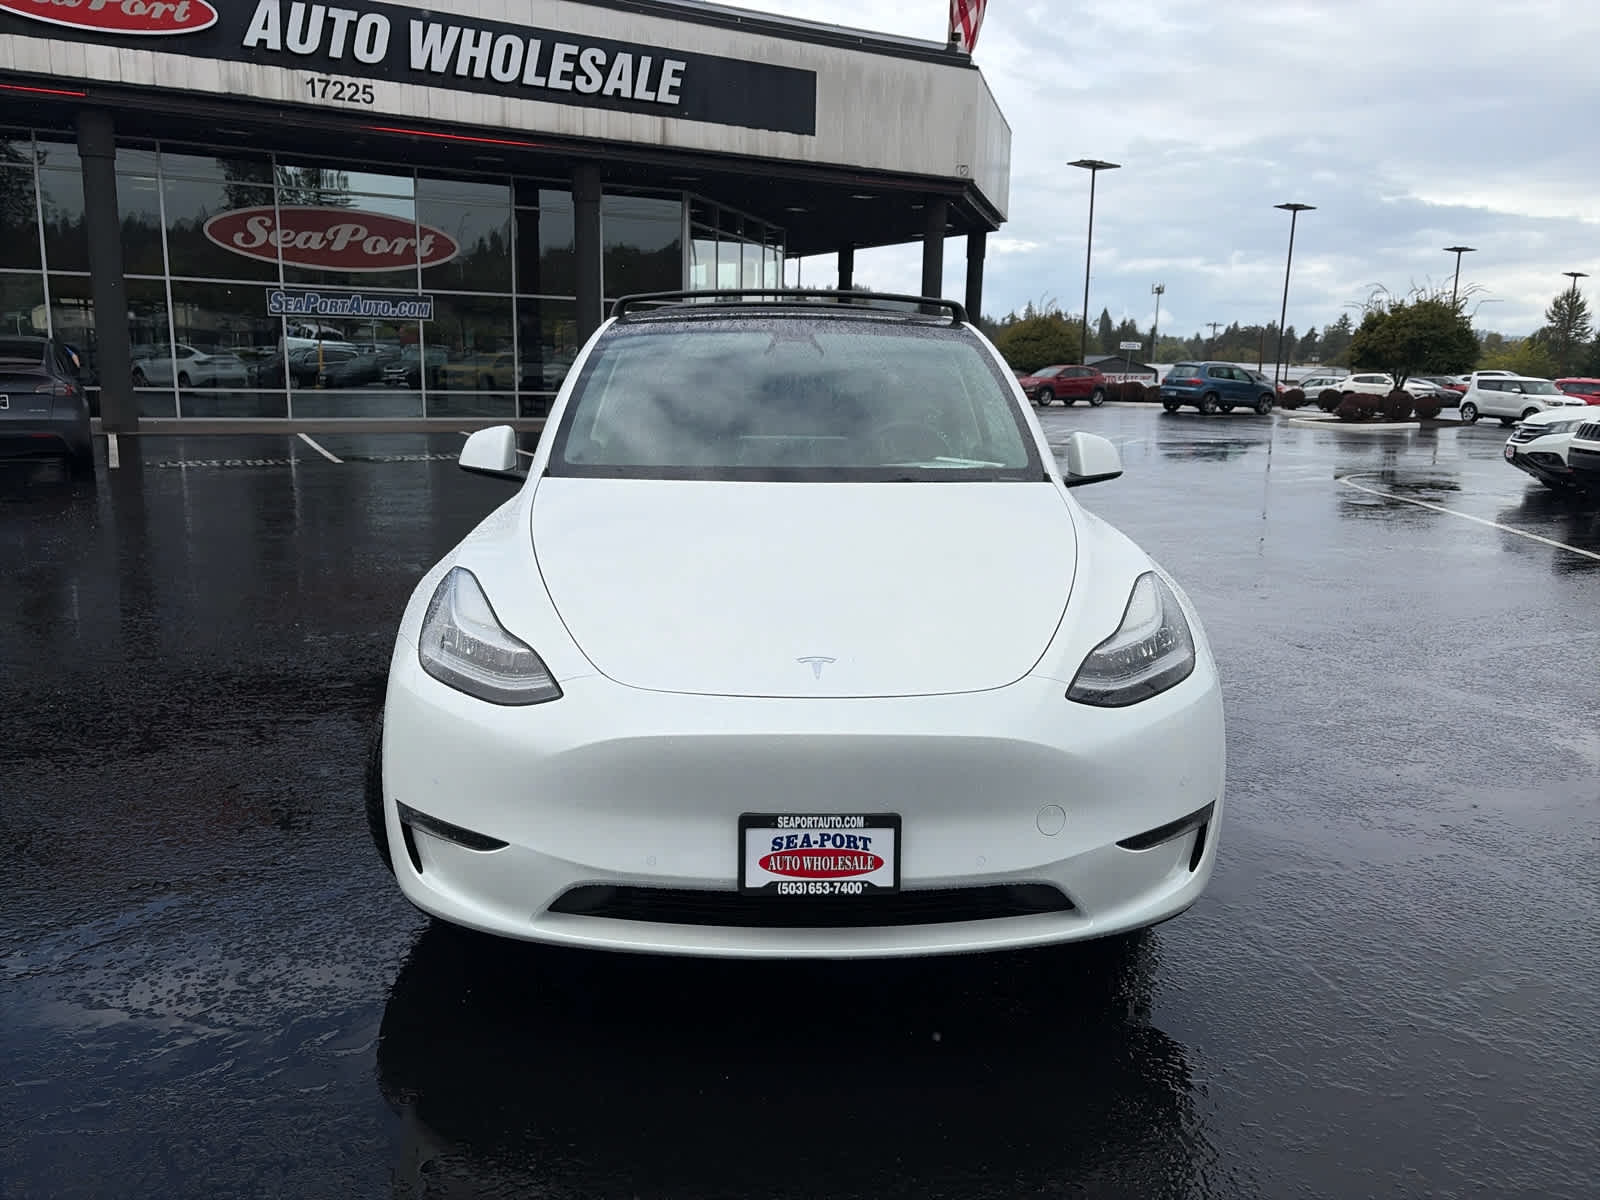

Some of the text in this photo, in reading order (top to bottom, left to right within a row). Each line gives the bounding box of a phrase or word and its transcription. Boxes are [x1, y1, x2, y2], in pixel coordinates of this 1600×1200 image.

[243, 0, 687, 105] AUTO WHOLESALE
[305, 77, 375, 105] 17225
[233, 215, 437, 258] SeaPort
[777, 816, 865, 829] SEAPORTAUTO.COM
[771, 833, 872, 851] SEA-PORT
[768, 856, 875, 872] AUTO WHOLESALE
